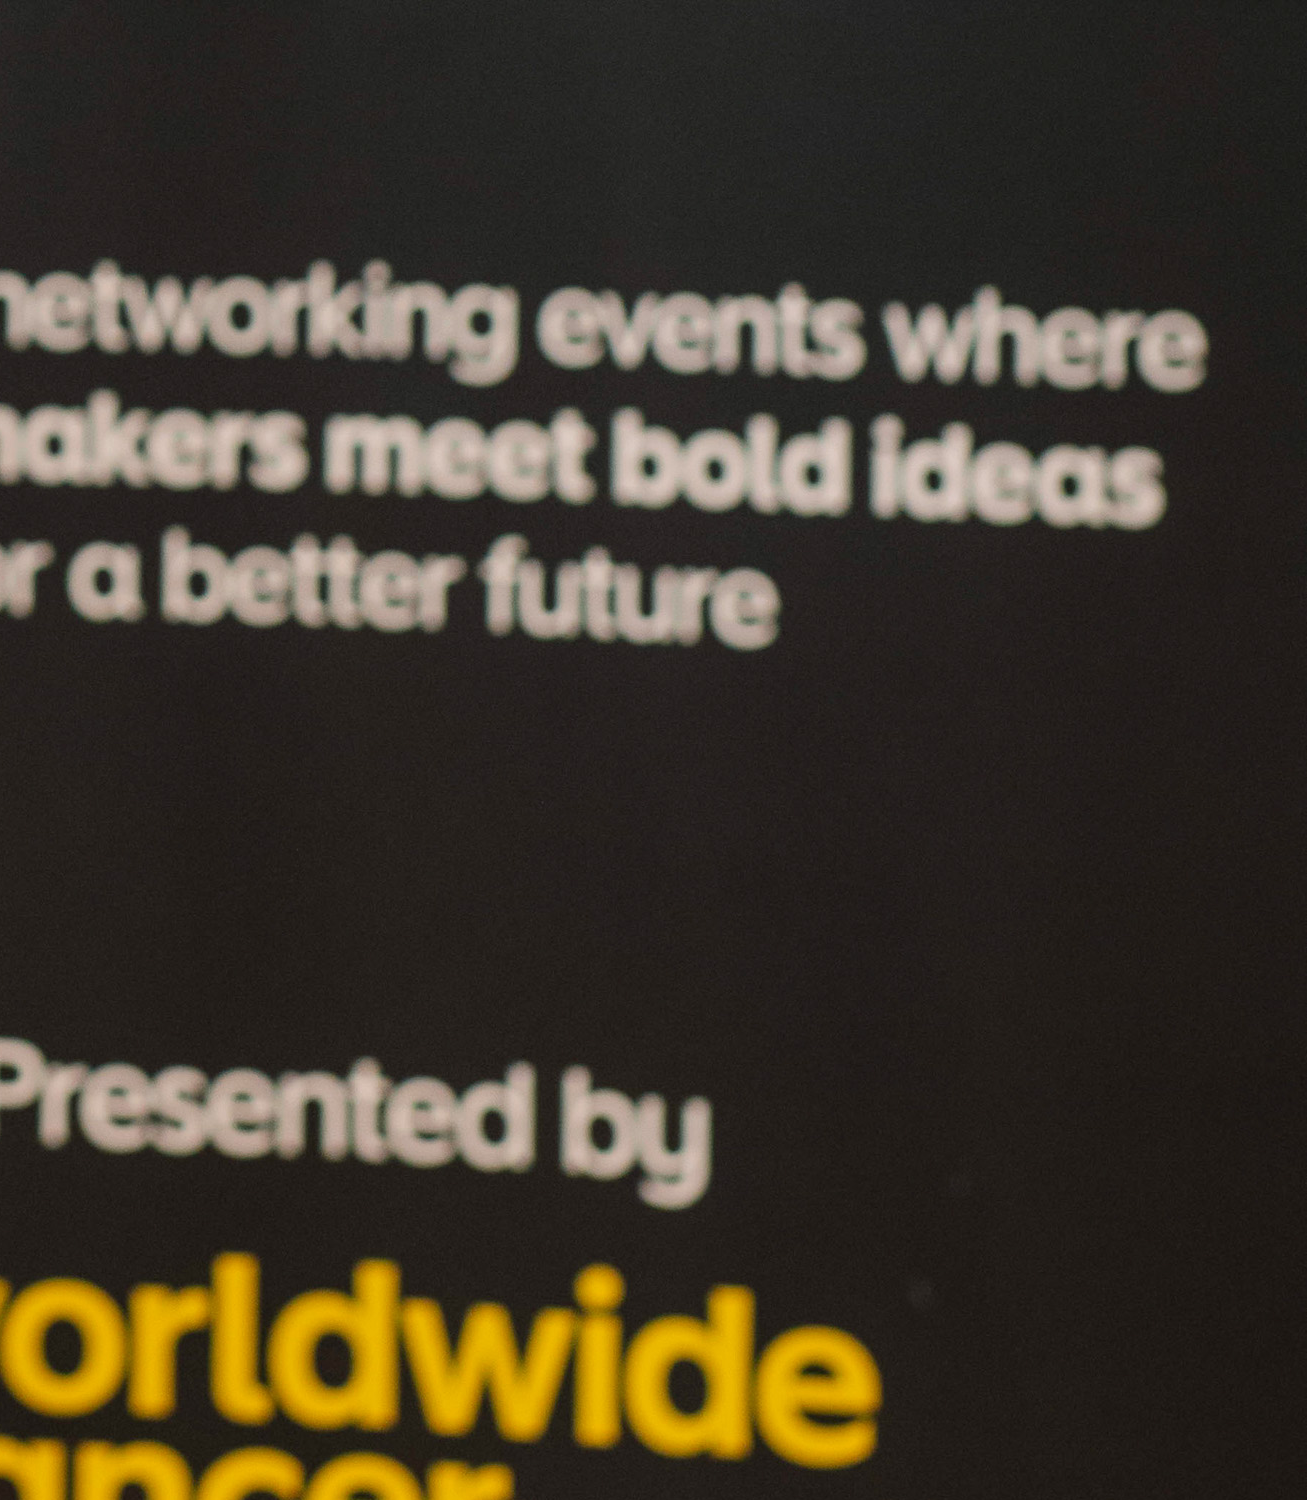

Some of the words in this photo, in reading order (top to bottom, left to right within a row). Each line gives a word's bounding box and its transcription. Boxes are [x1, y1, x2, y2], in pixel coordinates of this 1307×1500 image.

[534, 281, 869, 382] events
[881, 284, 1211, 394] where
[322, 406, 598, 506] meet
[609, 406, 854, 518] bold
[868, 412, 1168, 532] ideas
[65, 540, 145, 624] a
[159, 525, 468, 634] better
[478, 532, 783, 652] future
[558, 1064, 714, 1212] by
